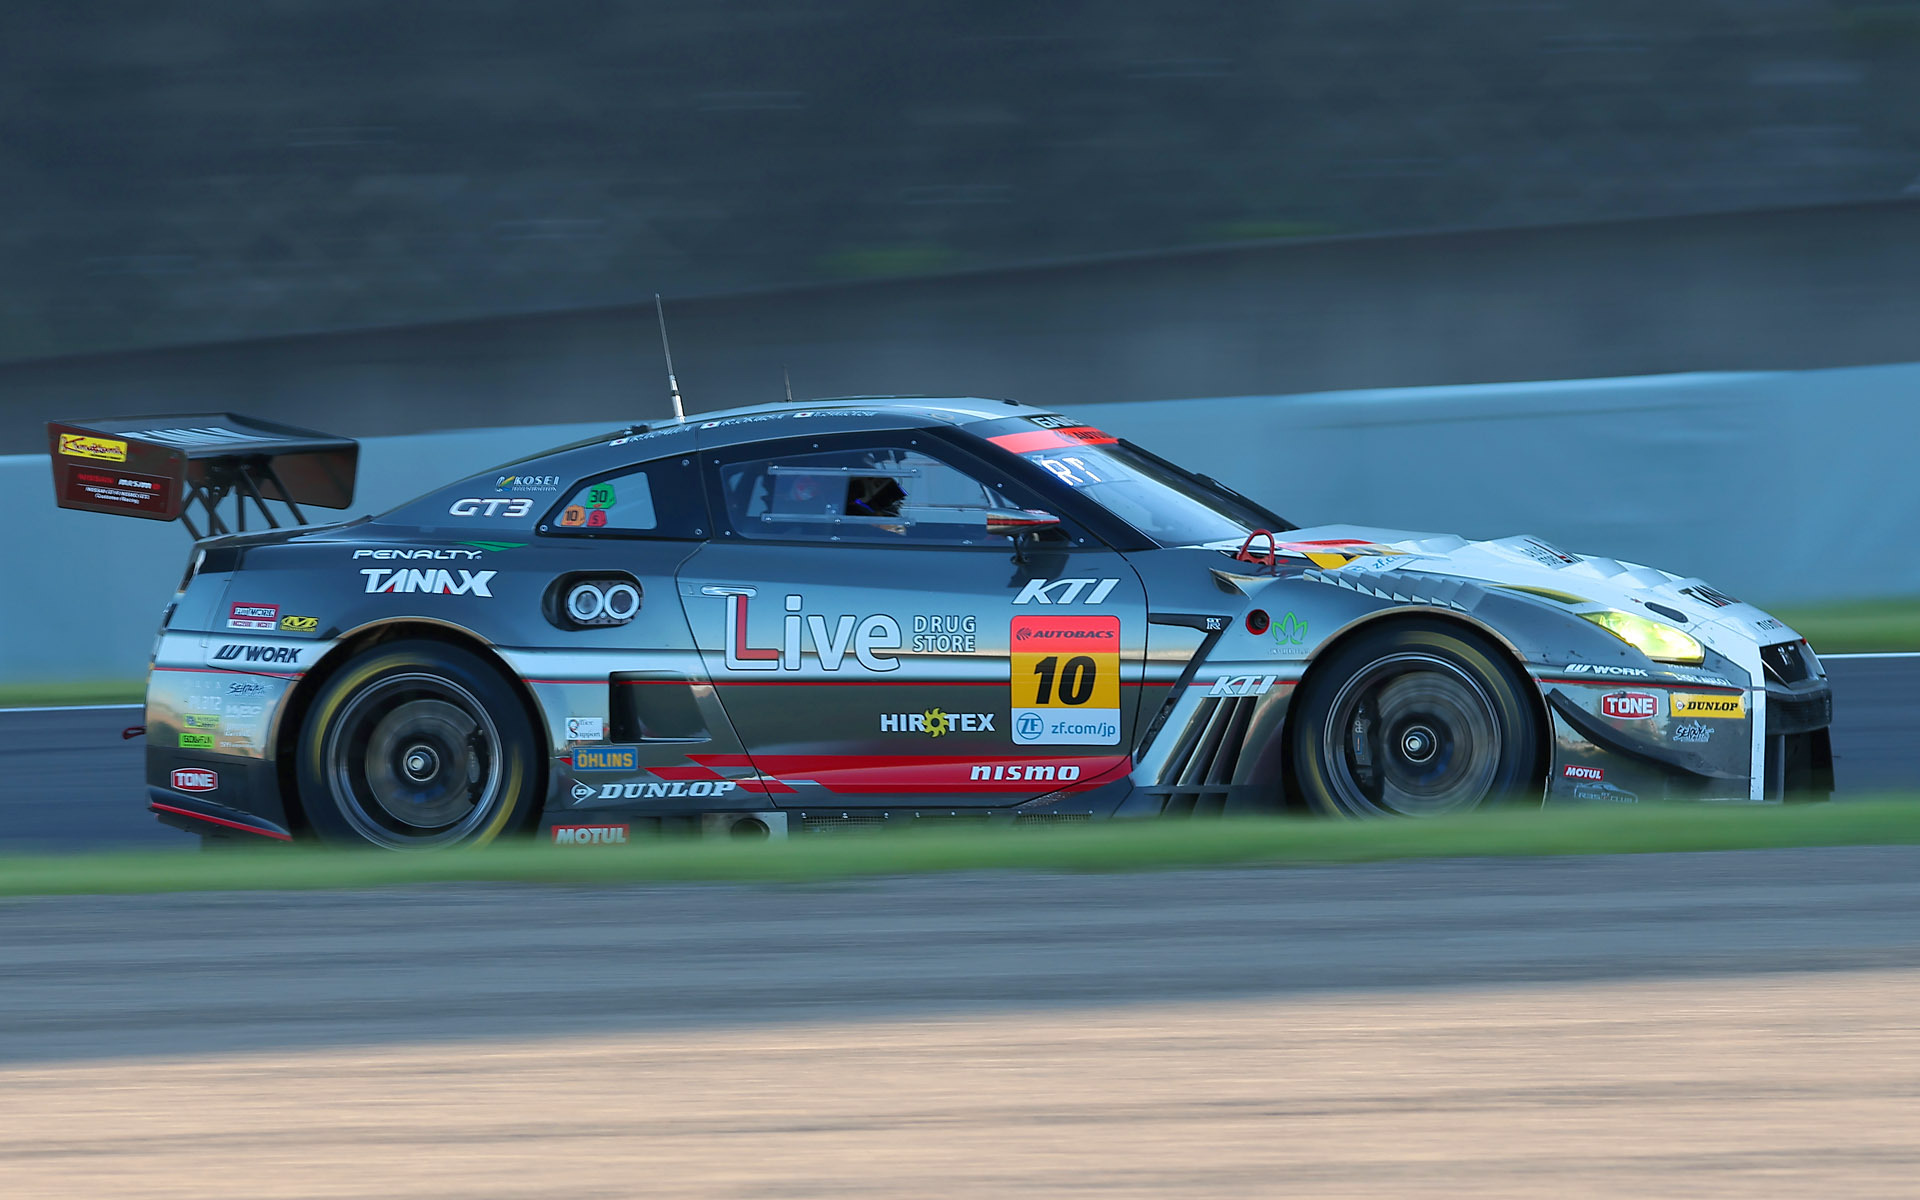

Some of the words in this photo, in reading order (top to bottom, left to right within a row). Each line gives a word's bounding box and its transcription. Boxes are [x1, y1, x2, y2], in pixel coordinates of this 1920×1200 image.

[513, 475, 560, 486] KOSEI
[590, 489, 608, 503] 30
[450, 498, 534, 517] GT3
[565, 510, 578, 521] 10
[352, 550, 483, 560] PENALTY
[359, 568, 498, 598] TANAX
[1012, 578, 1121, 605] KTI
[725, 594, 903, 672] Live
[913, 615, 977, 634] DRUG
[912, 634, 976, 653] STORE
[1033, 631, 1114, 639] AUTOBACS
[245, 646, 302, 663] WORK
[1594, 665, 1649, 677] WORK
[1033, 655, 1097, 706] 10
[1208, 675, 1278, 696] KTI
[1606, 697, 1654, 714] TONE
[1686, 701, 1739, 712] DUNLOP
[1020, 719, 1041, 733] ZF
[1051, 721, 1116, 738] zf.com/jp
[577, 749, 634, 769] ÖHLINS
[175, 772, 215, 788] TONE
[969, 765, 1081, 781] nismo
[1564, 766, 1602, 780] MOTUL
[597, 781, 737, 799] DUNLOP
[554, 827, 627, 845] MOTUL
